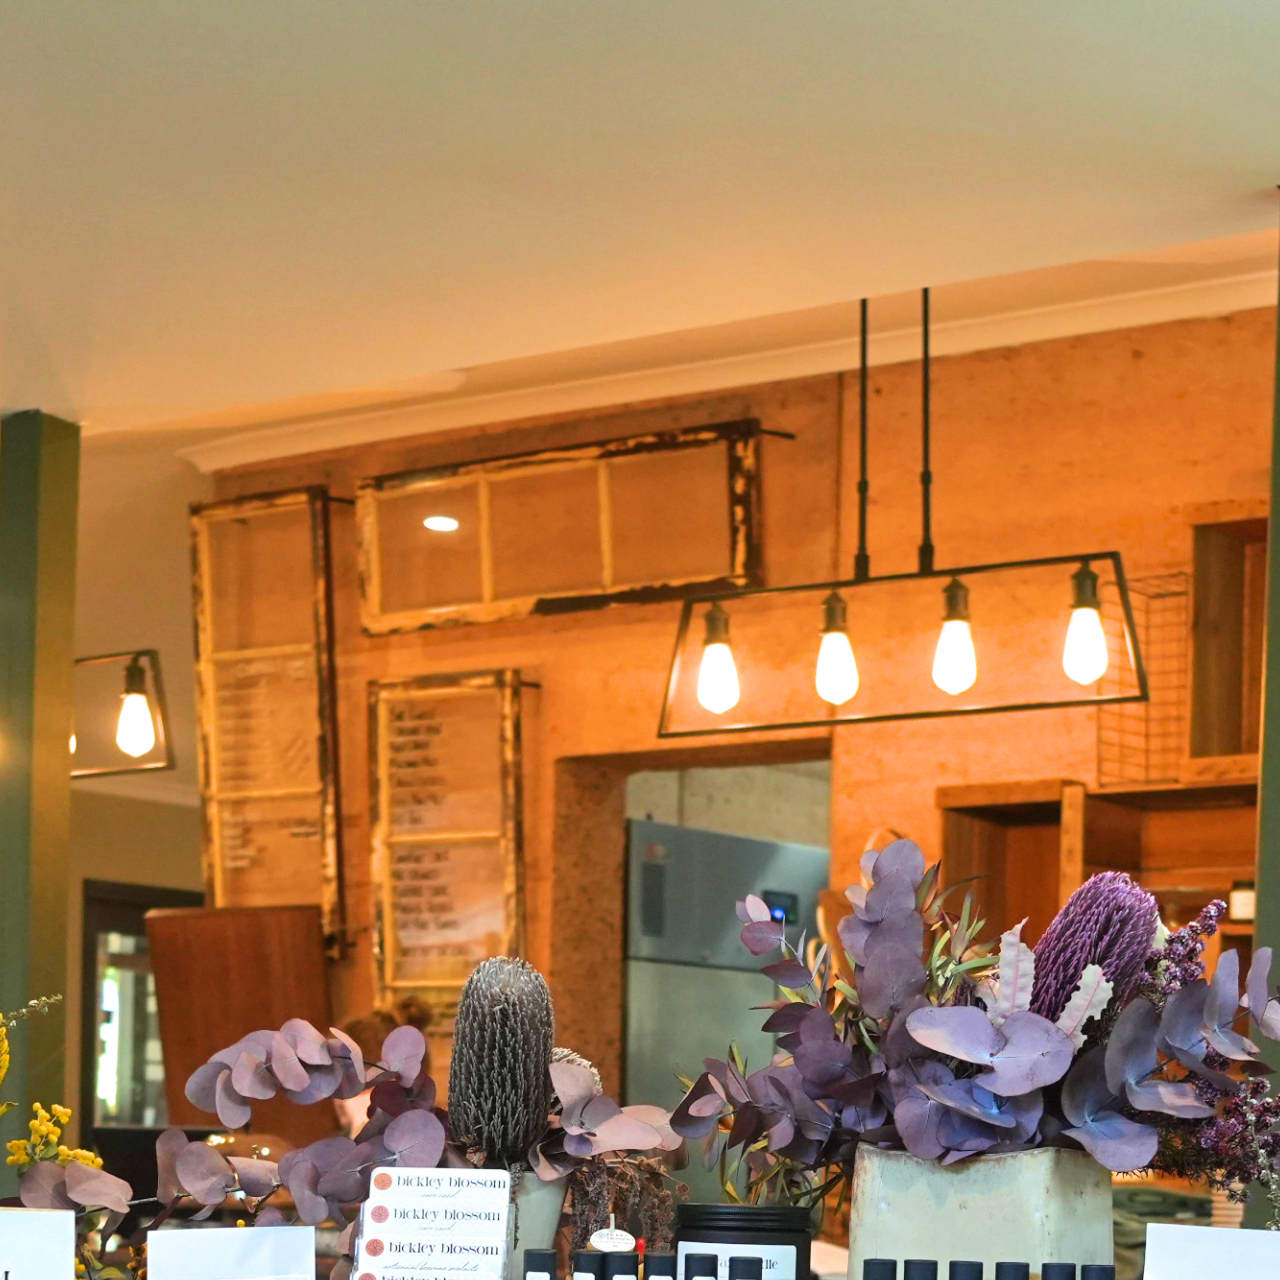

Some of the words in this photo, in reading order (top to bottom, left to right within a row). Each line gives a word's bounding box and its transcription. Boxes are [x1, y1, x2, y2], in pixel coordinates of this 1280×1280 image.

[397, 1176, 443, 1189] bickley
[449, 1177, 506, 1189] blossom
[394, 1208, 439, 1222] bickley
[444, 1209, 500, 1221] blossom
[389, 1242, 436, 1256] bickley
[441, 1243, 499, 1256] blossom
